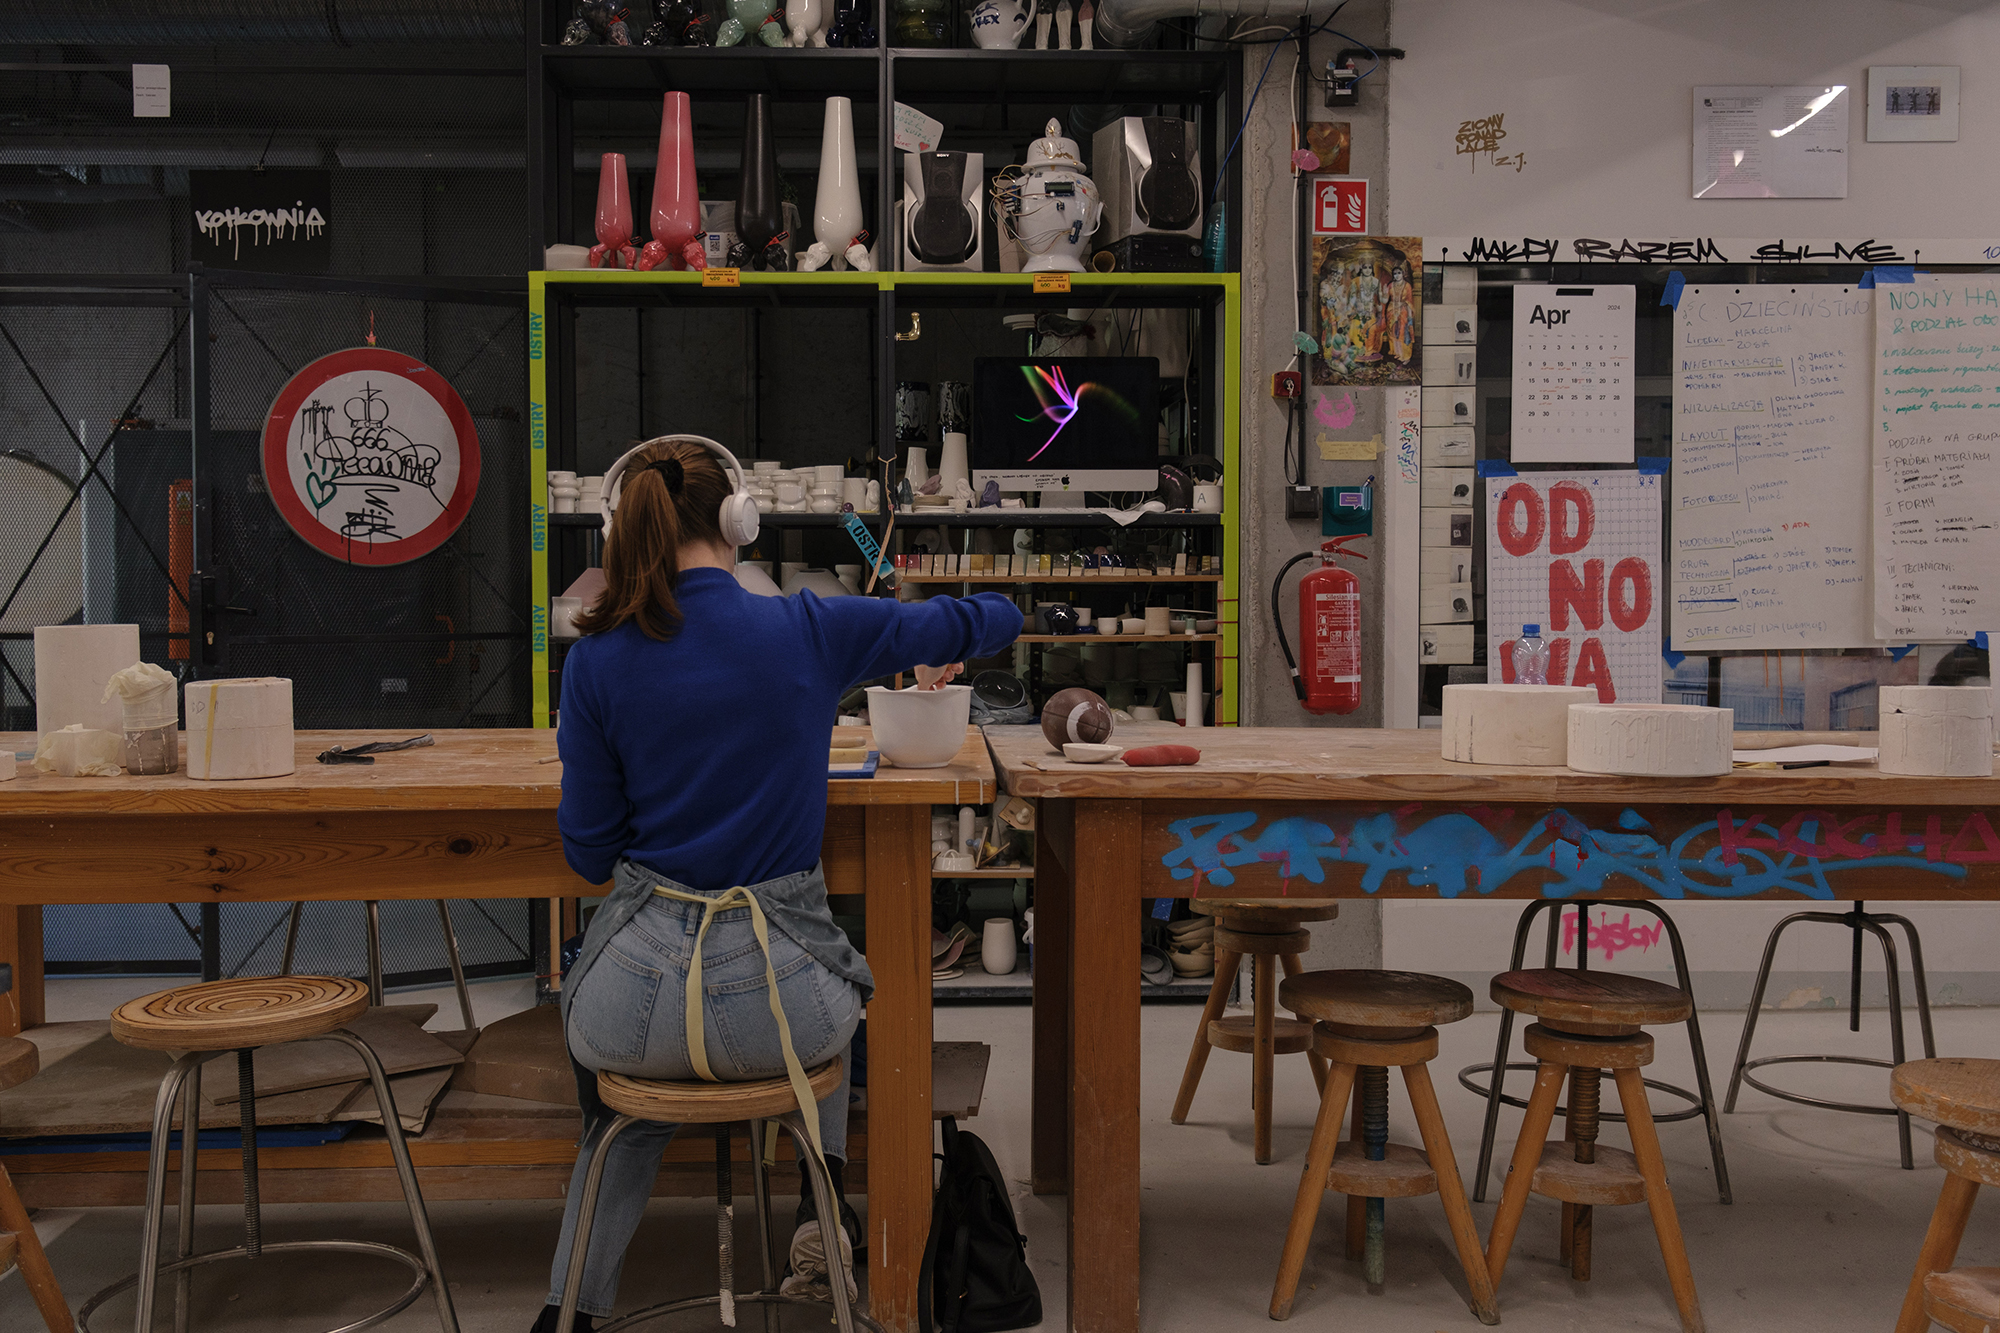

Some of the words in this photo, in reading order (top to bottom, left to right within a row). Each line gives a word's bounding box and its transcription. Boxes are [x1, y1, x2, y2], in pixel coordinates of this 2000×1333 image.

[1726, 292, 1869, 322] DZIECIŃSTWO
[1890, 289, 1954, 310] NOWY
[1965, 288, 2000, 308] HA
[1529, 304, 1570, 330] Apr
[530, 312, 543, 360] OSTRY
[1735, 325, 1792, 338] MARCELINA
[1808, 352, 1834, 361] JANEK
[531, 402, 545, 450] OSTRY
[1681, 428, 1727, 442] LAYOUT
[1883, 422, 1892, 432] 5.
[351, 427, 391, 449] 666
[1889, 435, 1933, 449] PODZIAŁ
[1944, 434, 1960, 442] NA
[532, 504, 546, 552] OSTRY
[1496, 480, 1596, 557] OD
[1792, 521, 1810, 530] ADA
[1680, 560, 1709, 569] GRUPA
[1680, 570, 1730, 580] TECHNICZNA
[1549, 556, 1652, 632] NO
[532, 604, 546, 652] OSTRY
[1686, 628, 1720, 638] STUFF
